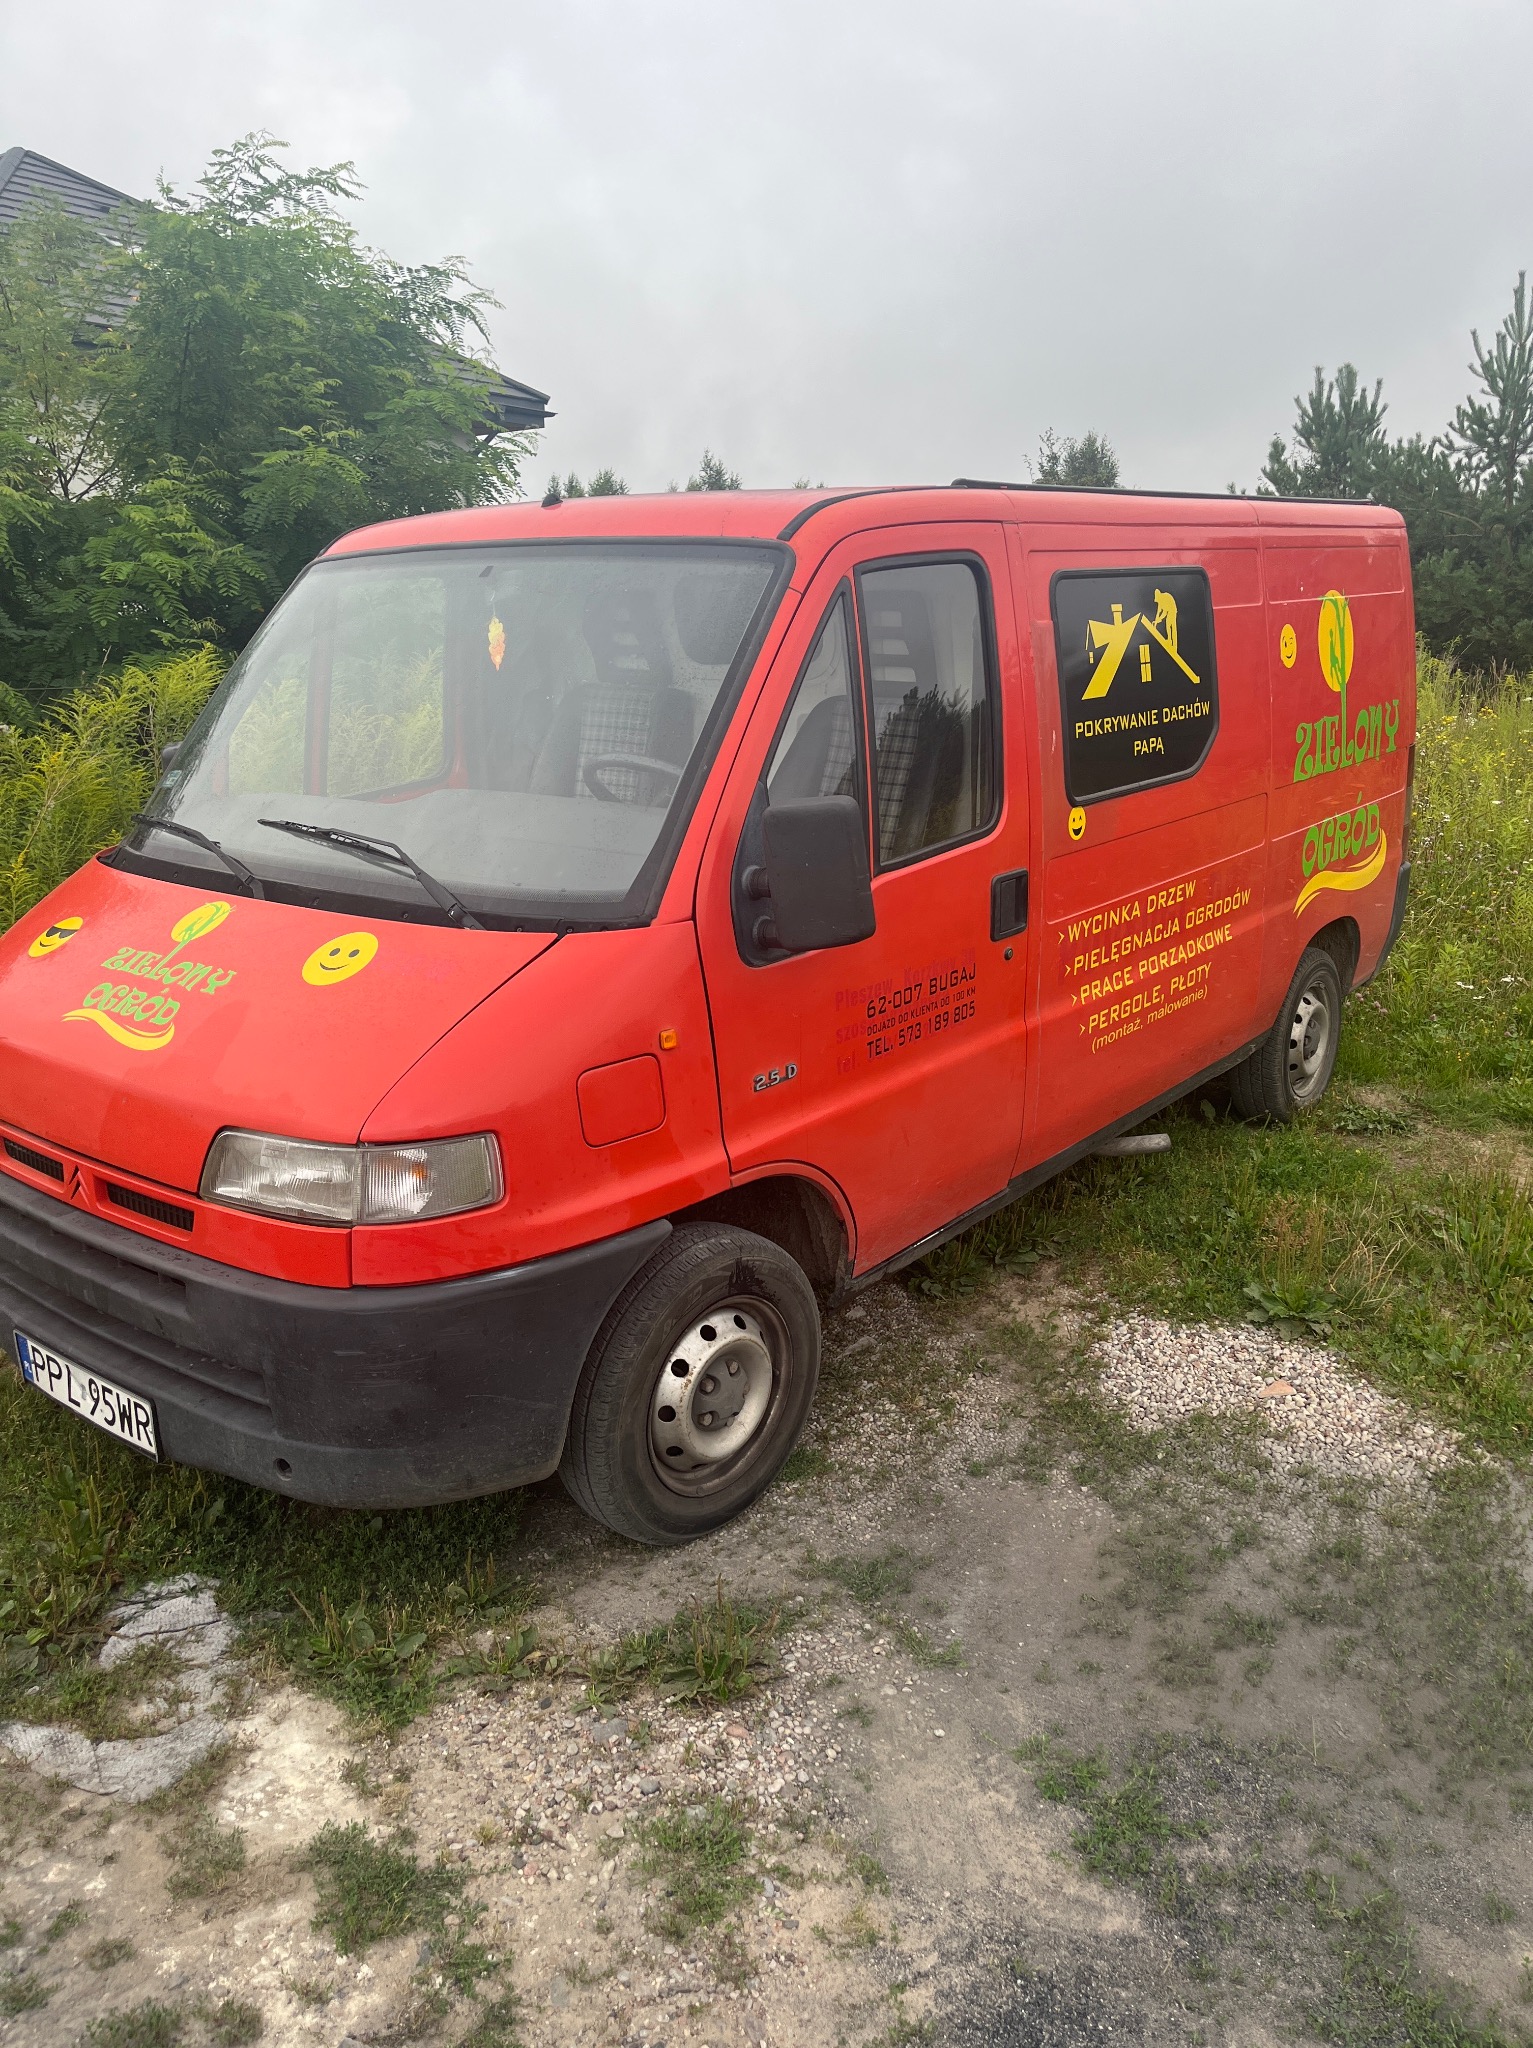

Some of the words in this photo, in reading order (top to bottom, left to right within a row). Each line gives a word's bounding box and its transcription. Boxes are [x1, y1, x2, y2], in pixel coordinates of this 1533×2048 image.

[1075, 709, 1159, 739] POKRYWANIE
[1162, 697, 1211, 723] DACHÓW
[1133, 736, 1165, 756] PAPĄ
[1293, 699, 1399, 783] ZIELONY
[1302, 791, 1380, 878] OGRÓD
[1067, 901, 1141, 943] WYCINKA
[1146, 880, 1197, 914] DRZEW
[1073, 917, 1180, 976] PIELĘGNACJA
[1185, 887, 1251, 930] OGRODÓW
[100, 946, 237, 994] ZIELONY
[866, 982, 922, 1019] 62-007
[929, 962, 976, 996] BUGAJ
[1079, 966, 1134, 1005] PRACE
[1138, 923, 1233, 980] PORZĄDKOWE
[82, 982, 181, 1025] OGRÓD
[867, 1017, 896, 1037] DOJAZD
[898, 1012, 909, 1025] DO
[910, 1002, 939, 1019] KLIENTA
[940, 996, 950, 1008] DO
[952, 989, 965, 1003] 100
[966, 986, 976, 998] KM
[1088, 985, 1165, 1034] PERGOLE,
[1170, 962, 1212, 996] PŁOTY
[1091, 1017, 1143, 1054] (montaż,
[1146, 985, 1208, 1024] malowanie)
[866, 1036, 894, 1059] TEL.
[898, 1021, 922, 1047] 573
[928, 1011, 949, 1034] 189
[953, 1000, 976, 1024] 805
[753, 1069, 780, 1092] 2.5
[786, 1063, 798, 1079] D
[31, 1344, 81, 1408] PPL
[88, 1378, 153, 1447] 95WR
